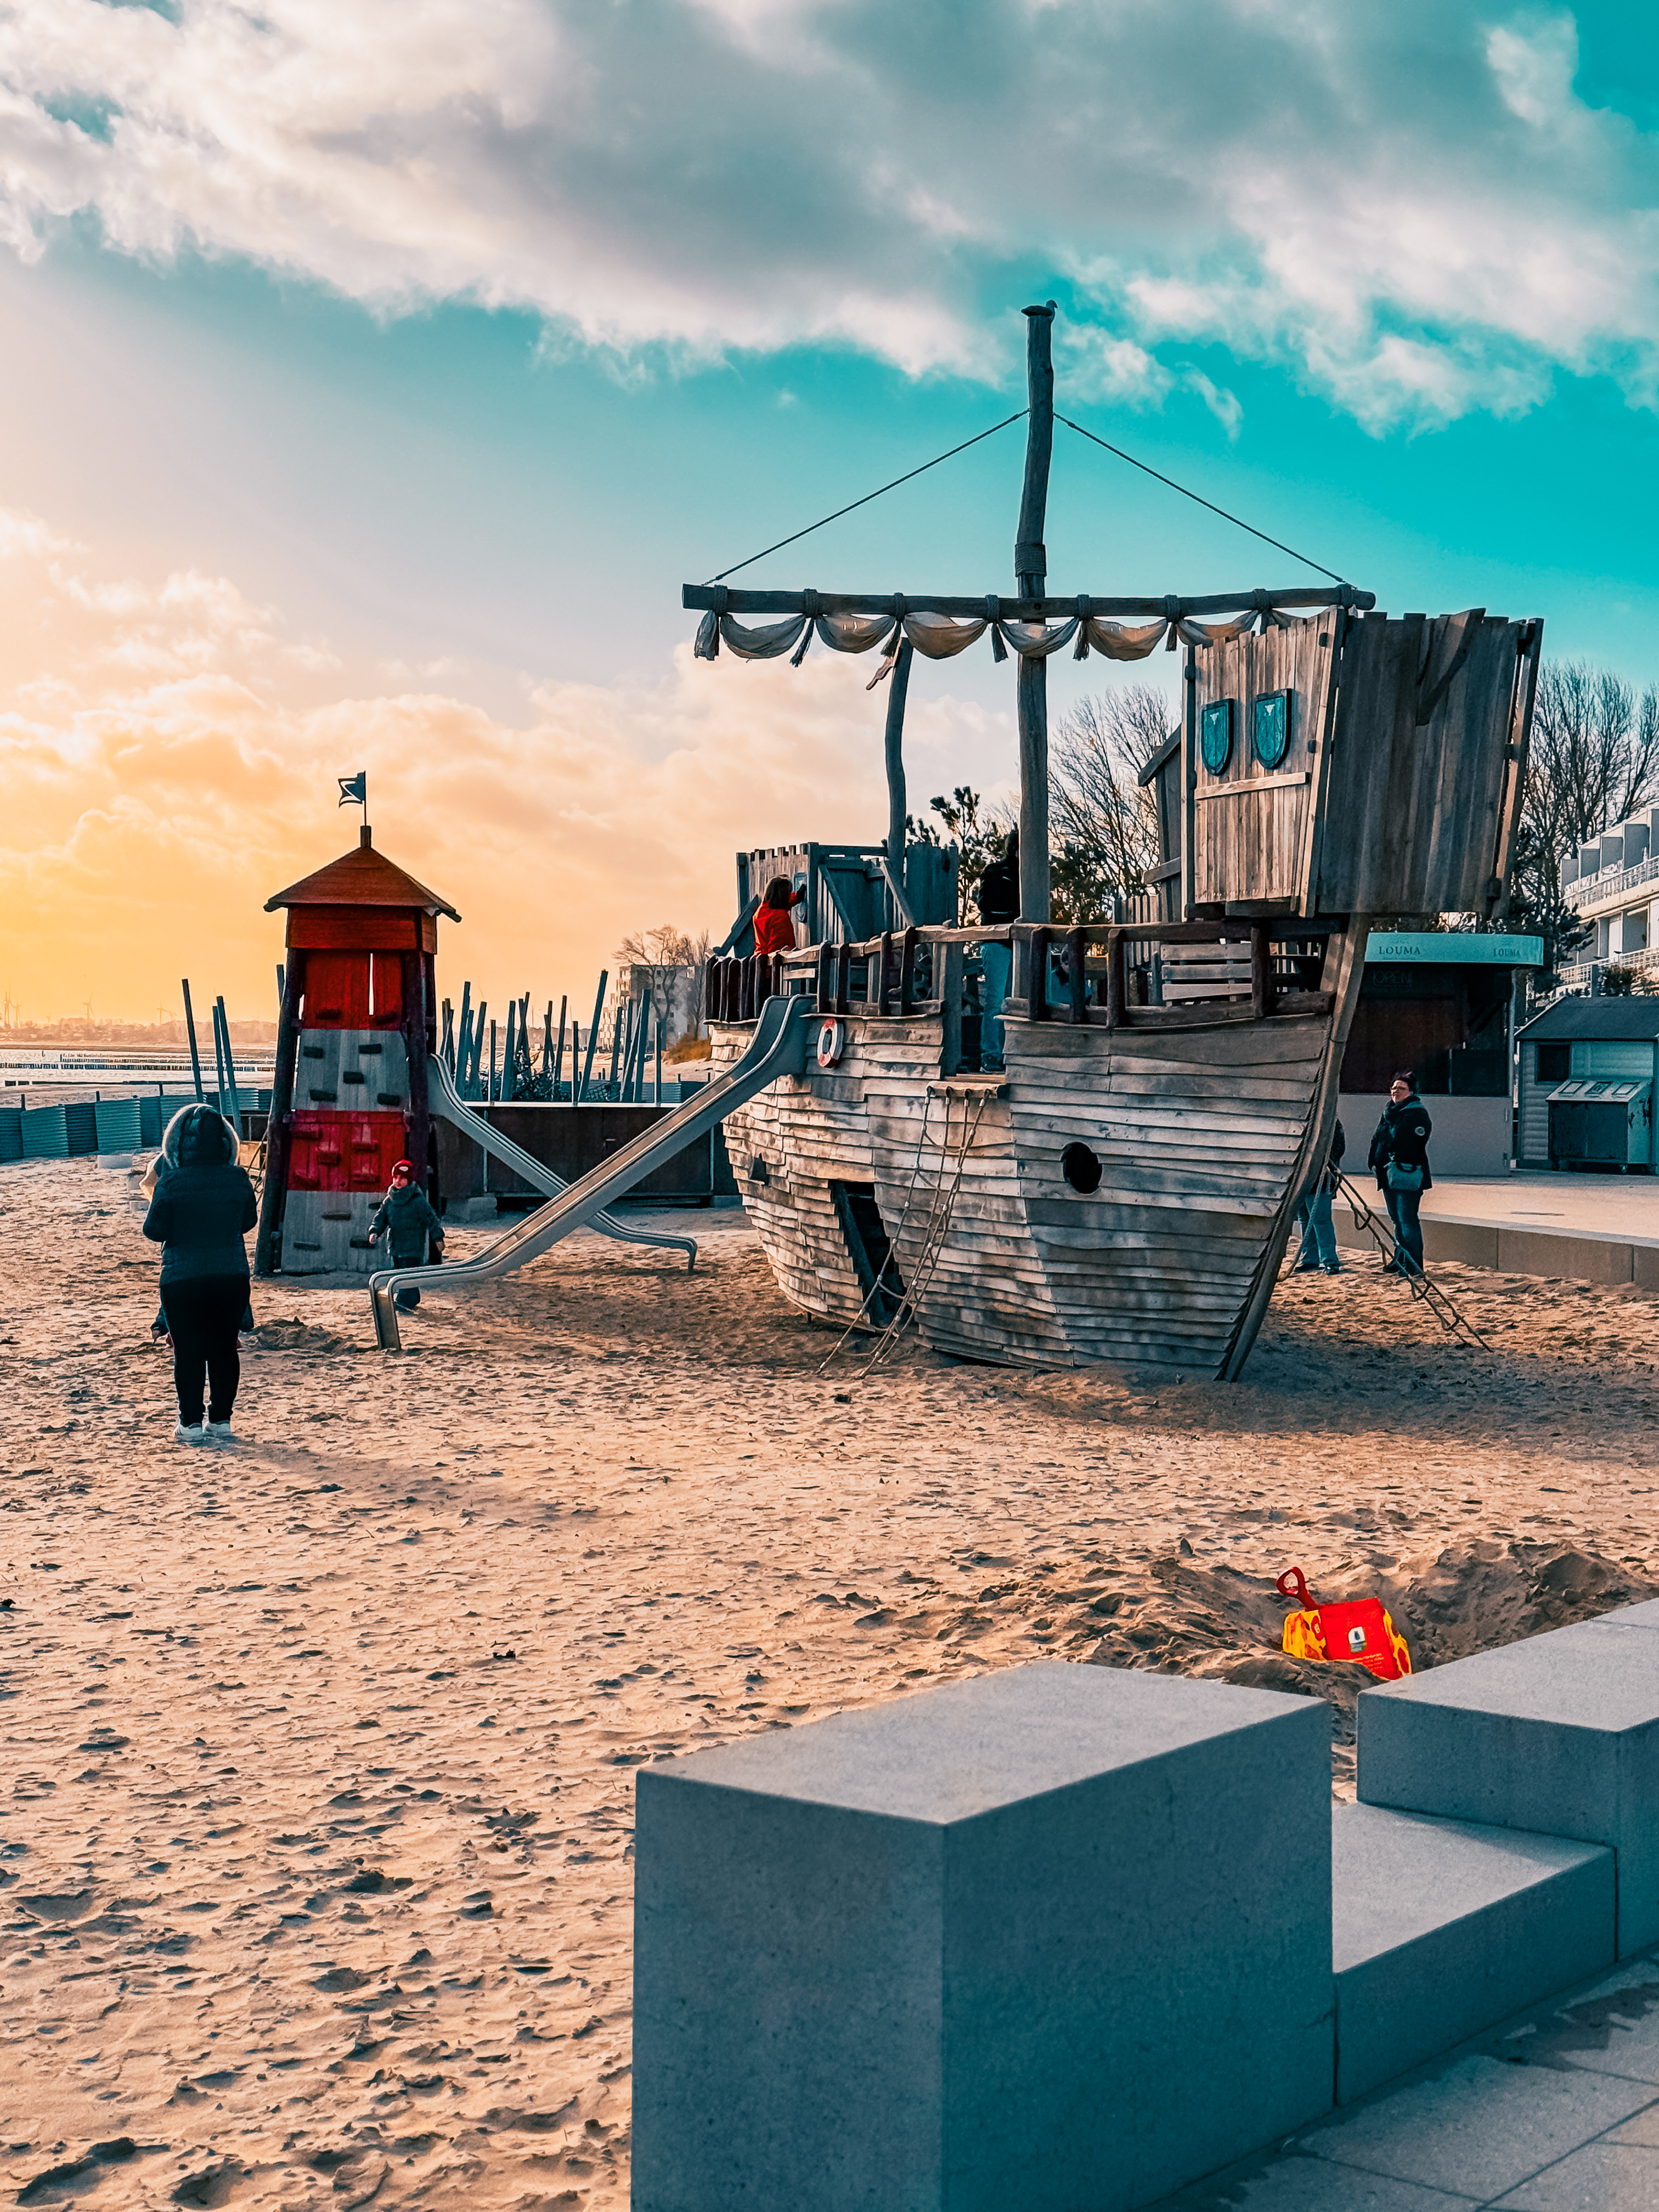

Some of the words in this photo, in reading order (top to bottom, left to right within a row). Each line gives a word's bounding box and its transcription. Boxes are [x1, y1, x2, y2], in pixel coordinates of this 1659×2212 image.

[1379, 946, 1421, 955] LOUMA
[1493, 947, 1521, 957] LOUMA
[1375, 969, 1410, 984] OPEN
